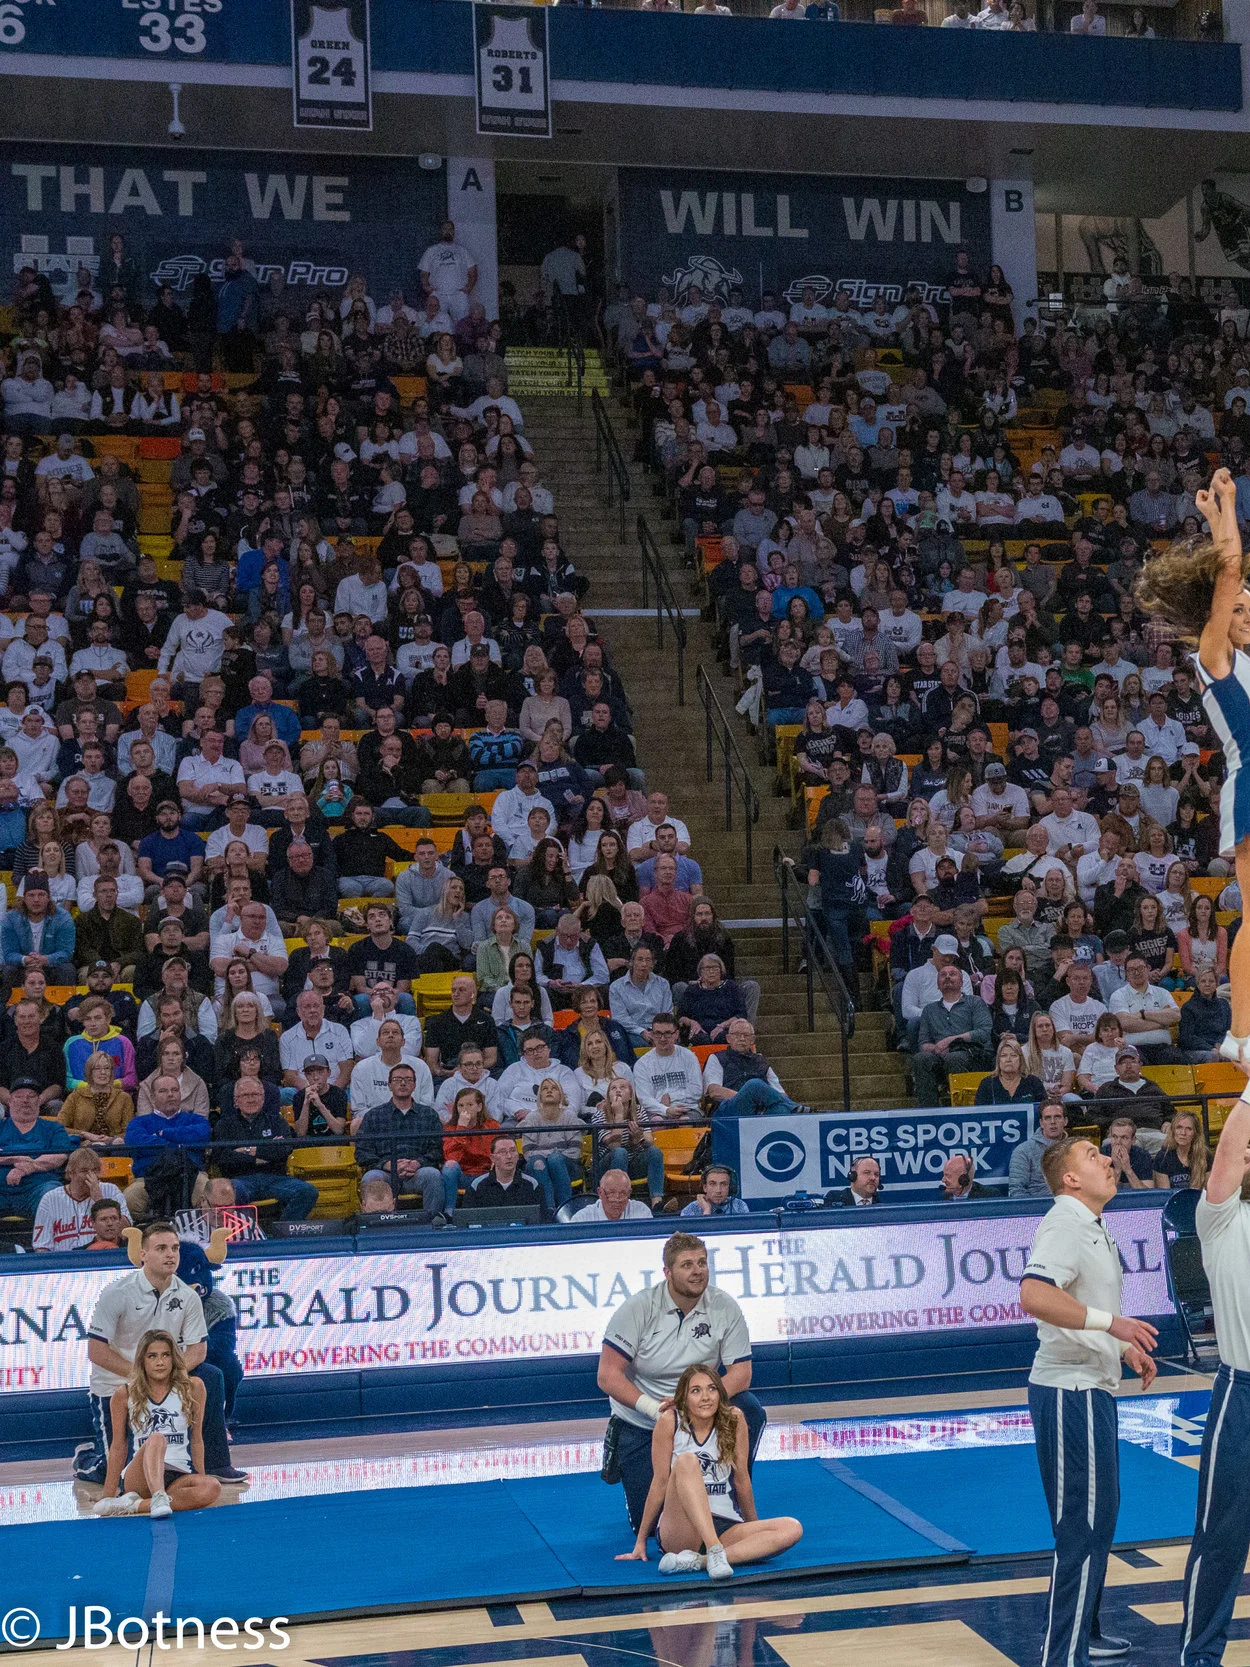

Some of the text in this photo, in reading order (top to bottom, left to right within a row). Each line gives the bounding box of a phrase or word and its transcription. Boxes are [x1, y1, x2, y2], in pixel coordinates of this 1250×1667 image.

[139, 12, 207, 53] 33
[311, 39, 351, 50] GREEN
[487, 49, 538, 60] ROBERTS
[308, 56, 357, 87] 24
[493, 65, 533, 94] 31
[11, 164, 351, 222] THAT WE
[460, 168, 483, 191] A
[1004, 190, 1024, 212] B
[659, 190, 961, 244] WILL WIN
[287, 260, 348, 285] Pro
[1072, 1022, 1096, 1030] HOOPS
[827, 1119, 1021, 1151] CBS SPORTS
[35, 1225, 45, 1242] 7
[762, 1237, 806, 1256] THE
[233, 1267, 281, 1287] THE
[706, 1245, 926, 1299] HERALD
[228, 1284, 411, 1331] ERALD
[777, 1307, 919, 1335] EMPOWERING
[923, 1306, 964, 1327] THE
[0, 1304, 90, 1345] NA
[244, 1330, 596, 1371] EMPOWERING THE COMMUNITY
